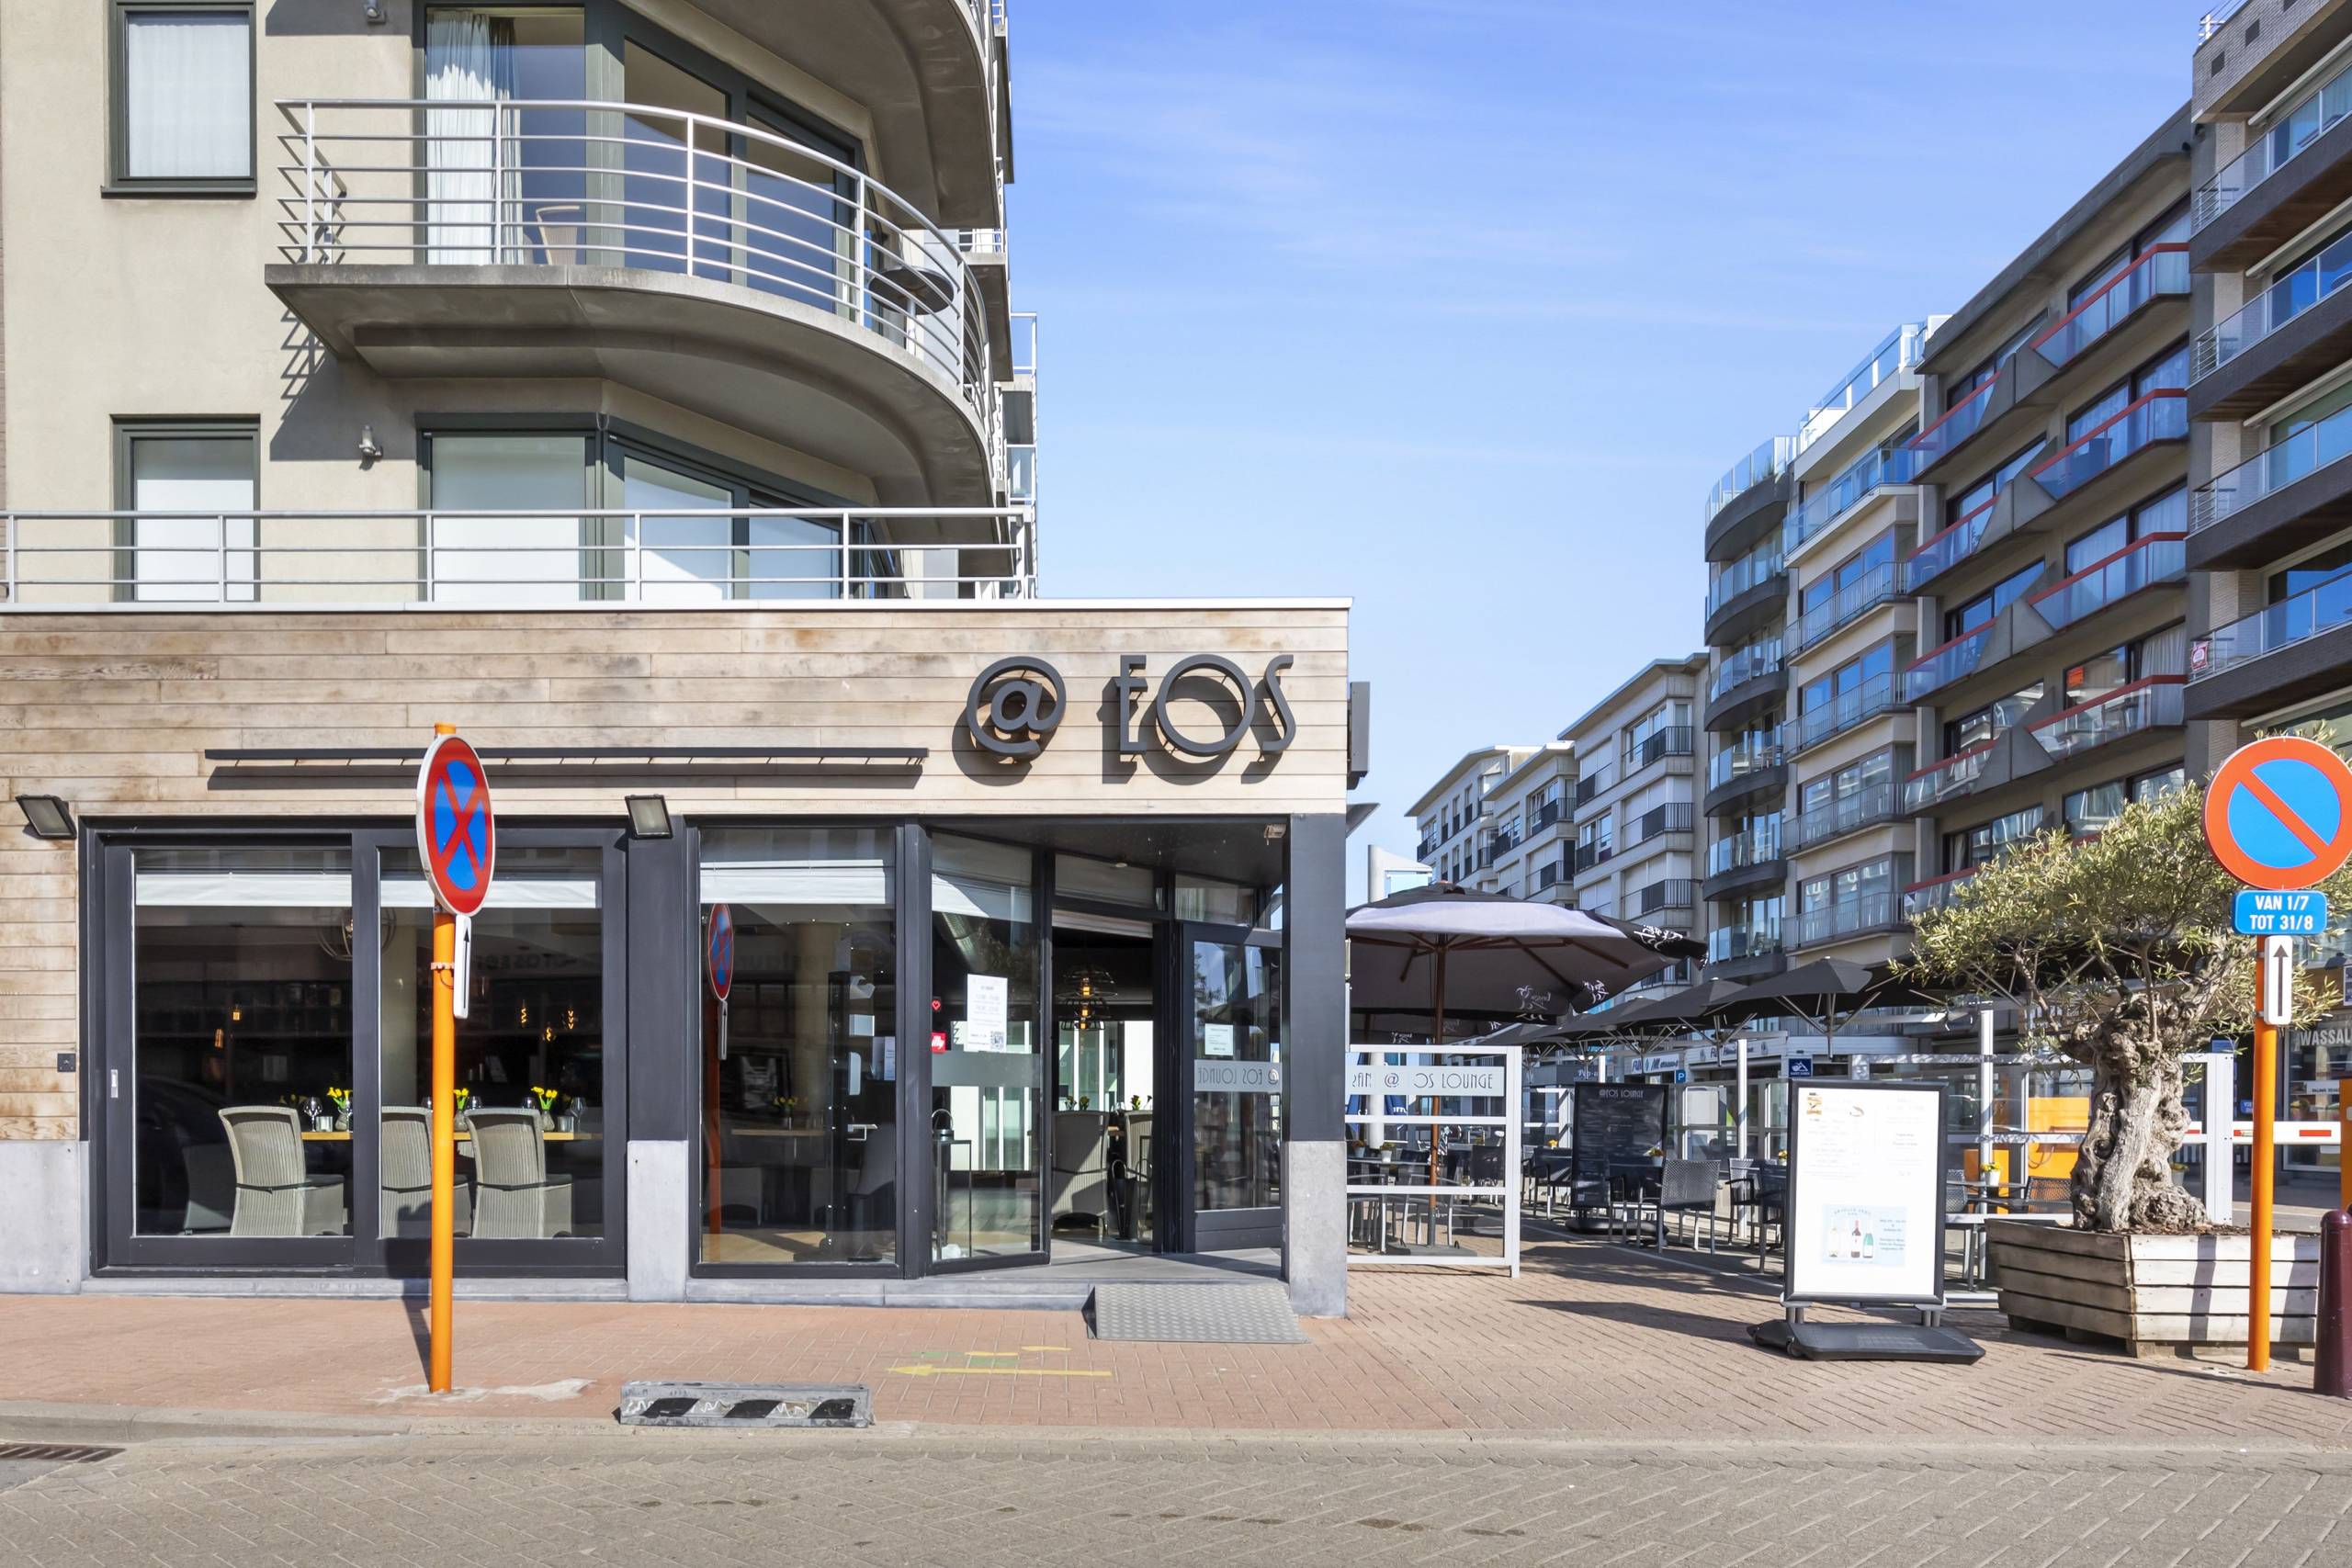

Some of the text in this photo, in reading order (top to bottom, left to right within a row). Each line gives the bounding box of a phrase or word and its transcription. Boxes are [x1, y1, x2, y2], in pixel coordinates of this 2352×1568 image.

[967, 656, 1067, 757] @
[2255, 895, 2310, 910] VAN 1/7
[2249, 914, 2313, 930] TOT 31/8
[1385, 1072, 1399, 1089] @
[1442, 1073, 1493, 1089] LOUNGE
[1678, 1072, 1685, 1080] P
